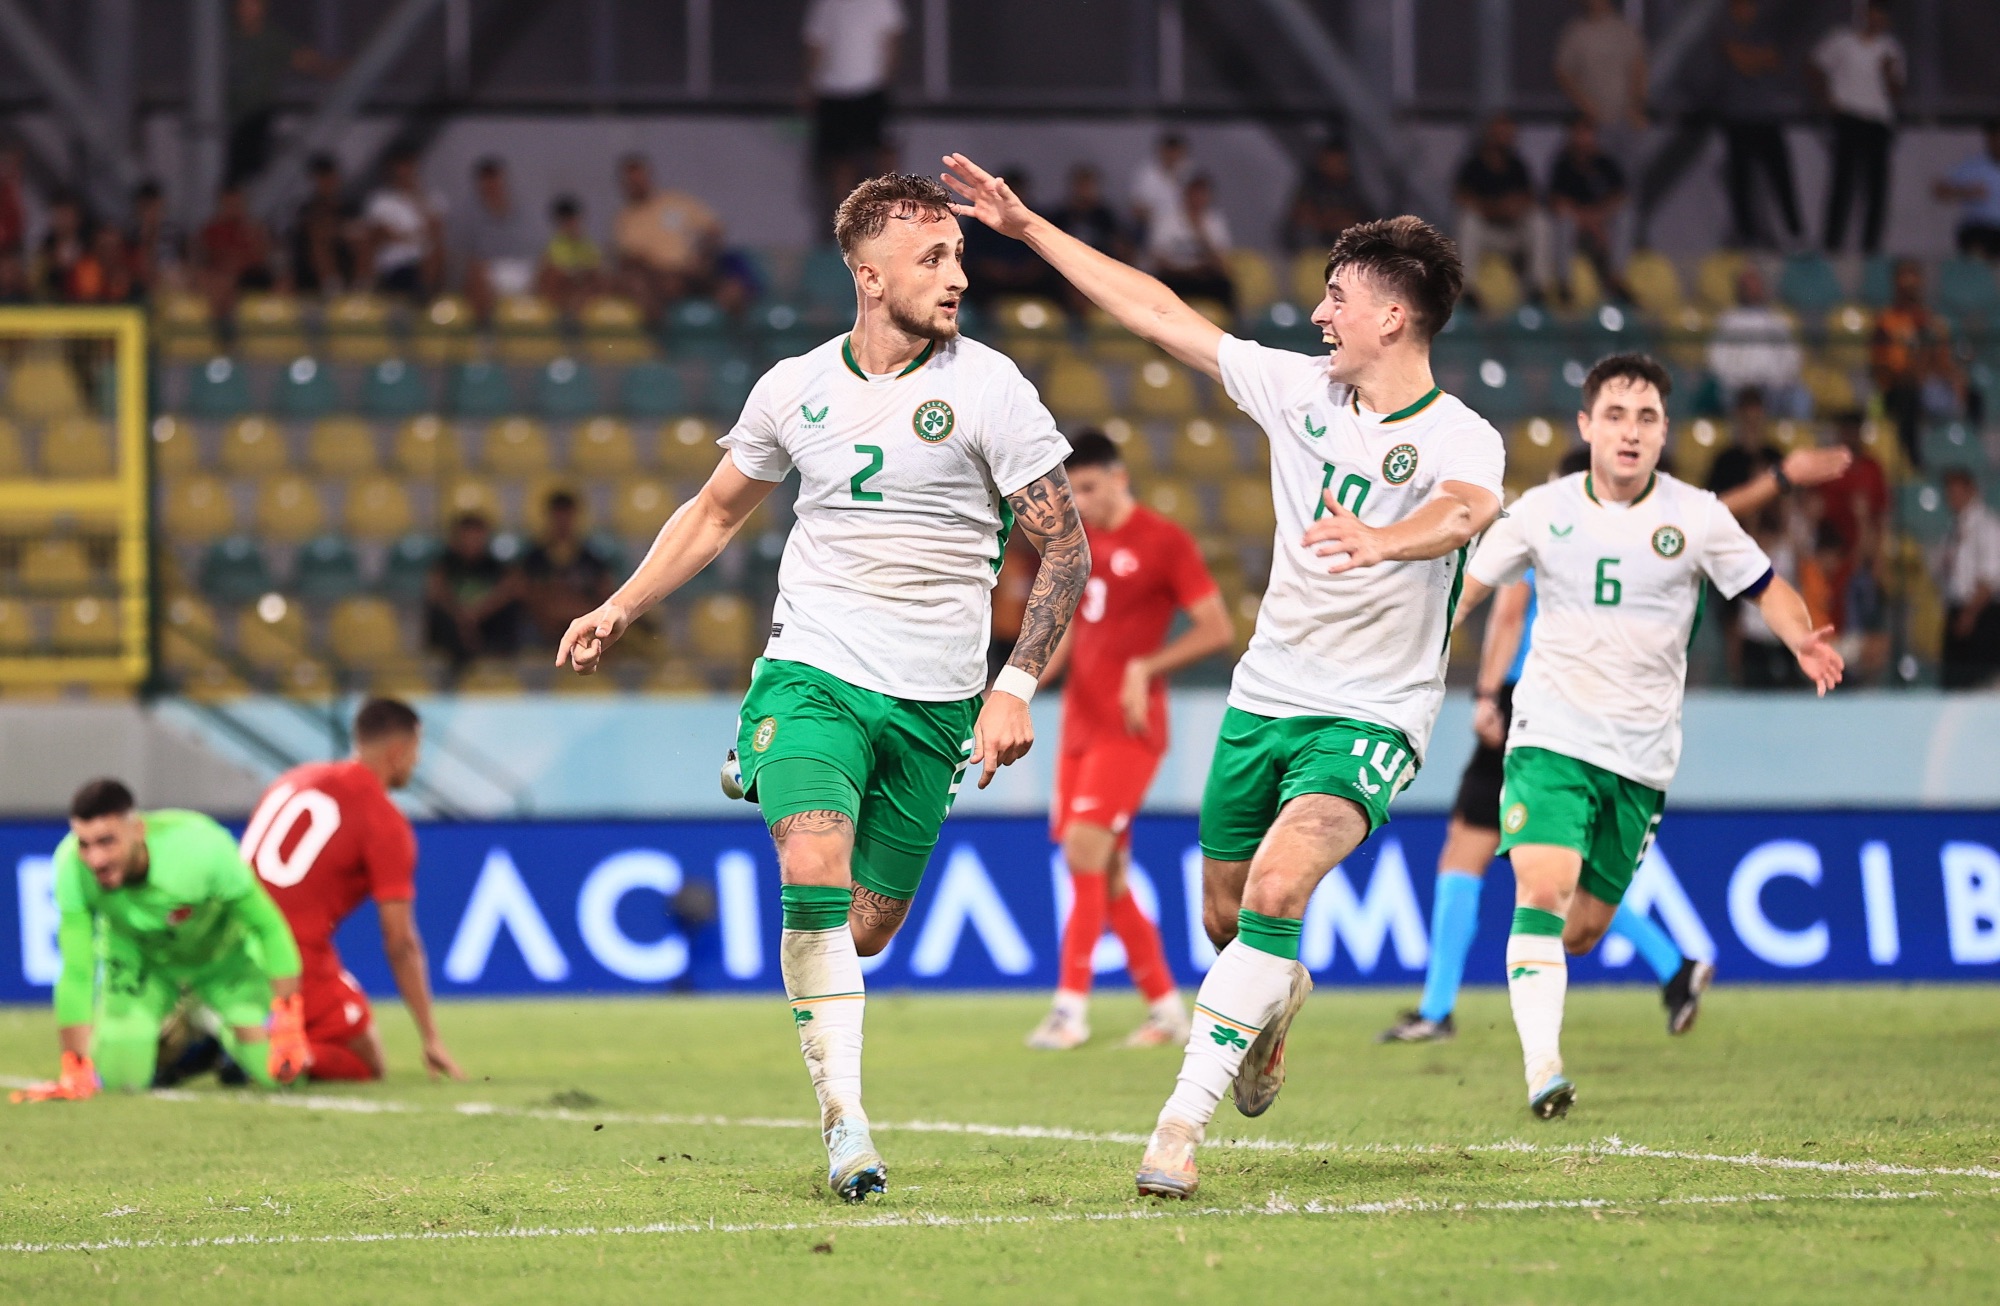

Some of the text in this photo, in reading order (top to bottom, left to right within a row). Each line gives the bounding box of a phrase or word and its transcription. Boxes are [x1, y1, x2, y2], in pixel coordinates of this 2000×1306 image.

[850, 444, 884, 502] 2
[1313, 461, 1372, 522] 10
[1594, 558, 1622, 606] 6
[239, 782, 342, 889] 10
